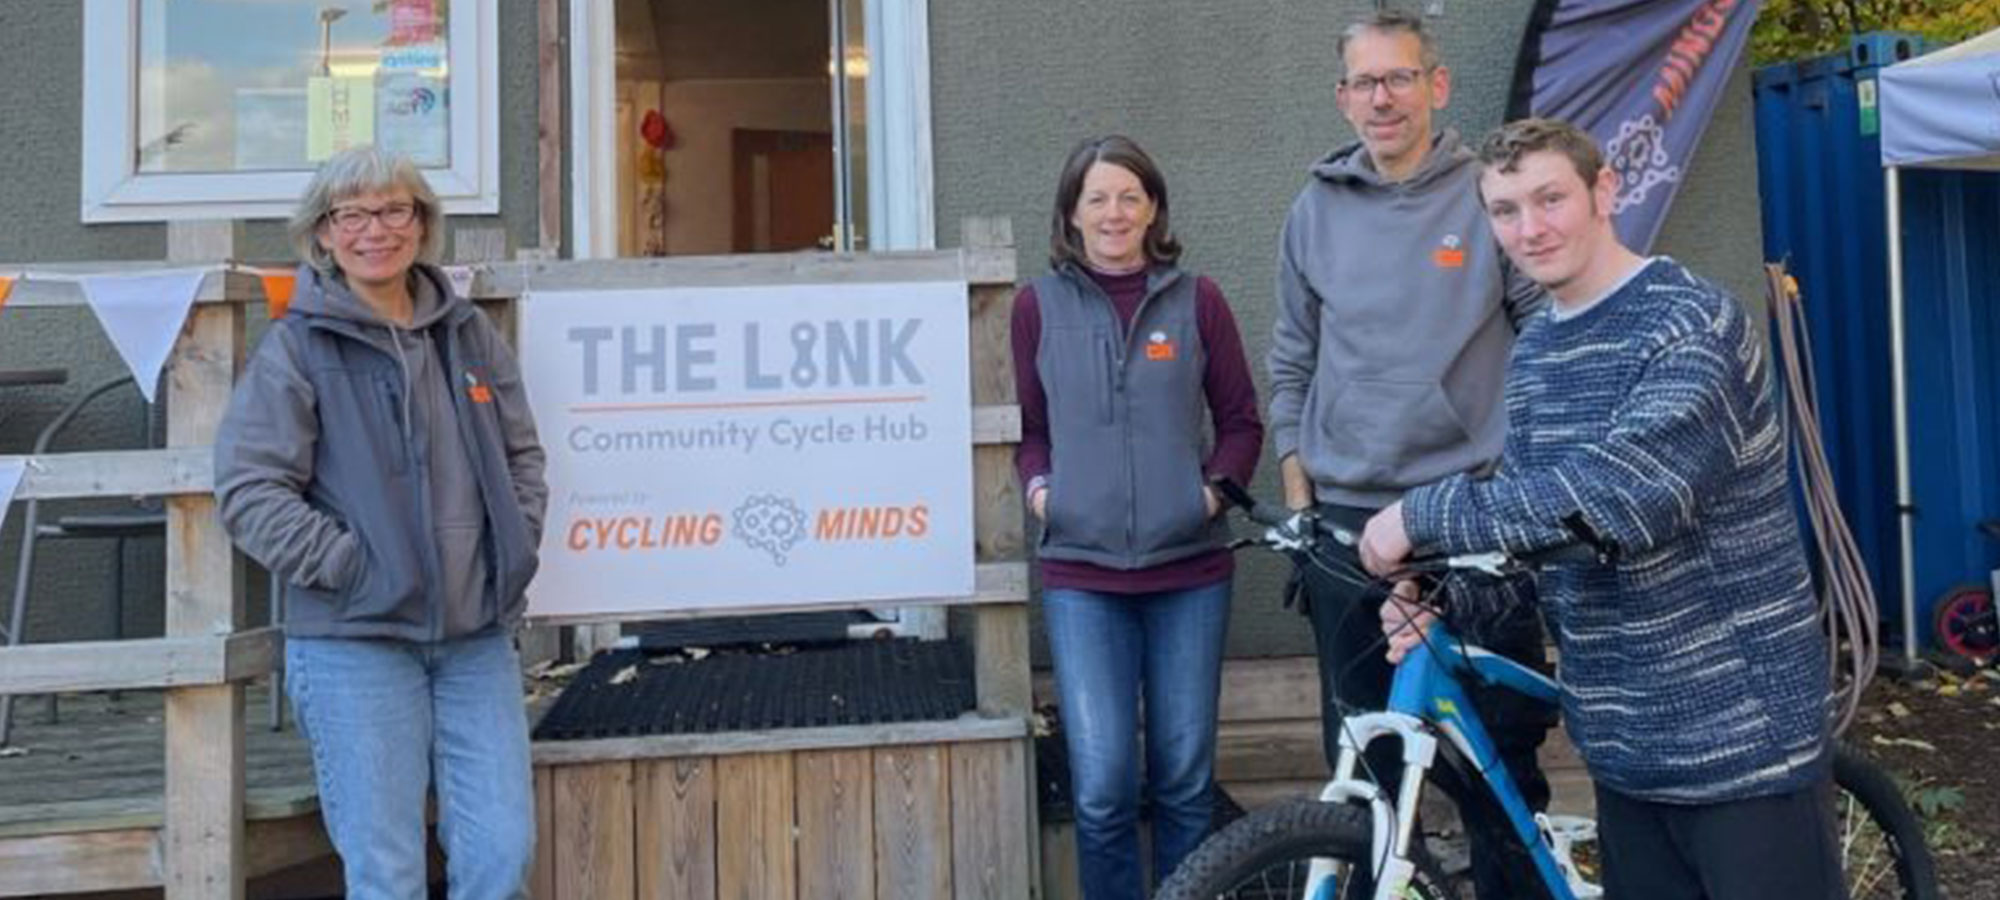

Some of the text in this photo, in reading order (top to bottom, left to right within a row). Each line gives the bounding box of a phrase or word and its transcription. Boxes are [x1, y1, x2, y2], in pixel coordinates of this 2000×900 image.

[567, 317, 926, 396] THE LINK
[567, 412, 928, 454] Community Cycle Hub
[567, 504, 929, 551] CYCLING MINDS
